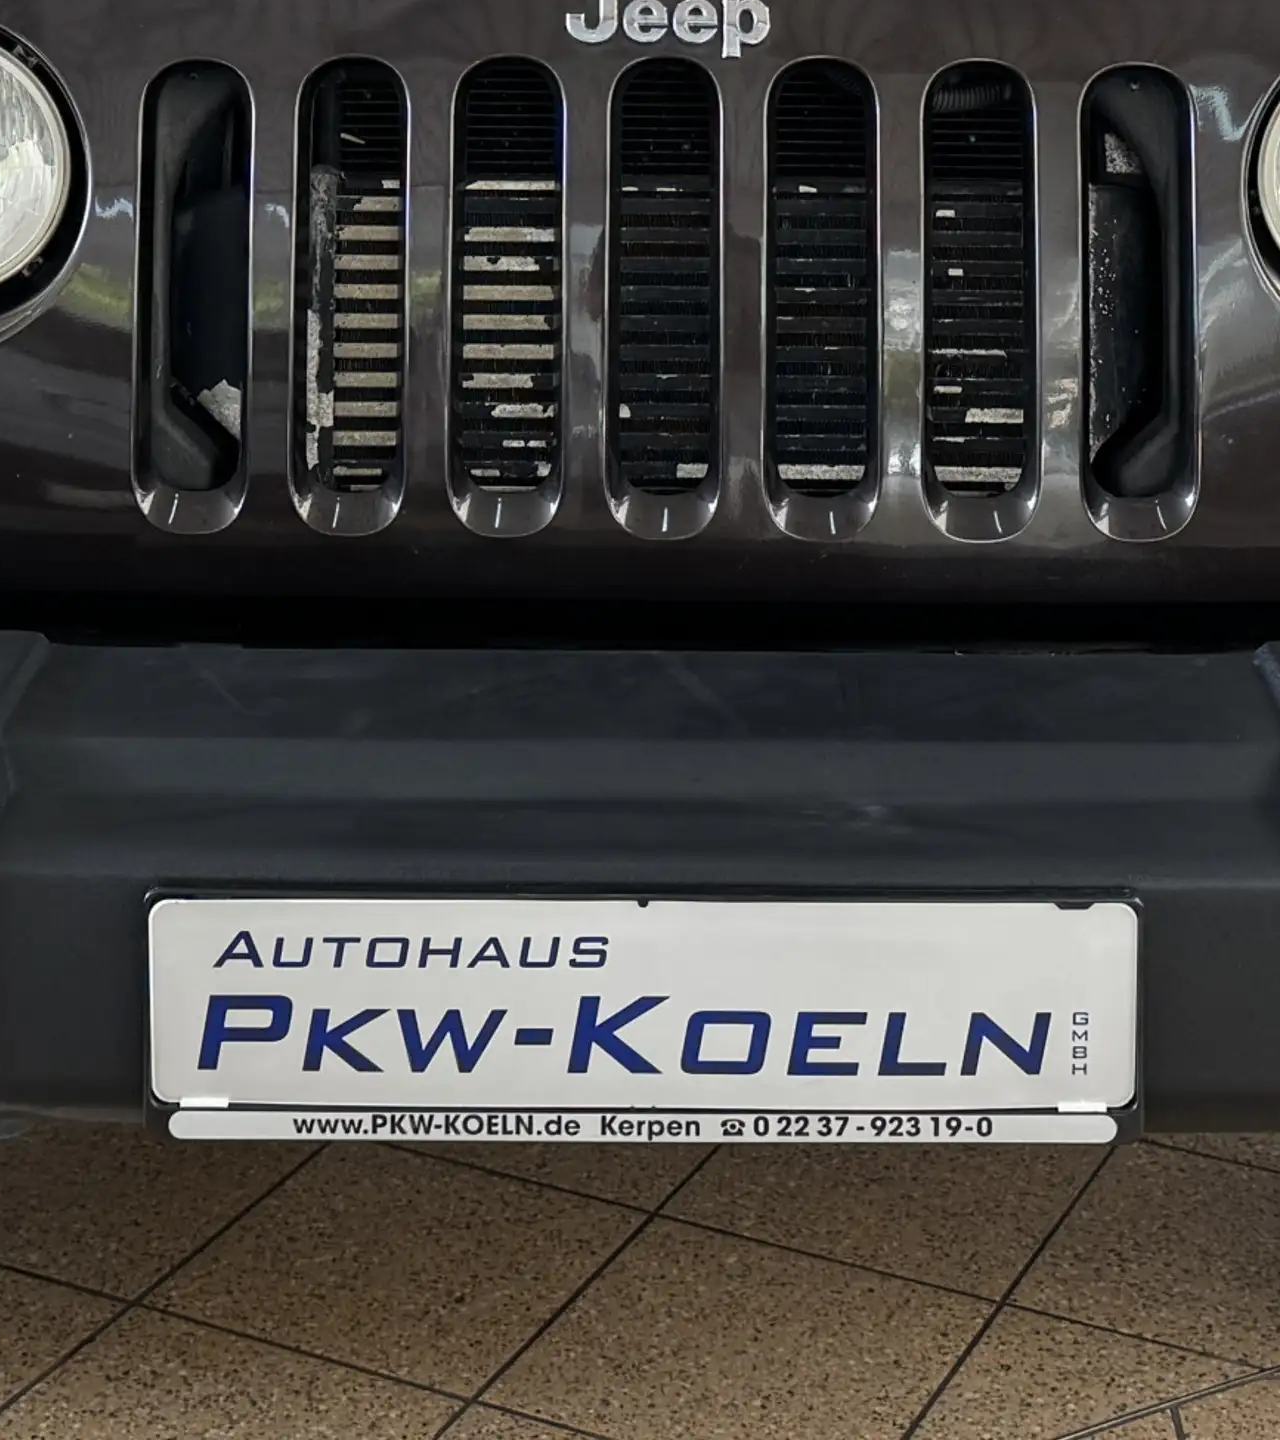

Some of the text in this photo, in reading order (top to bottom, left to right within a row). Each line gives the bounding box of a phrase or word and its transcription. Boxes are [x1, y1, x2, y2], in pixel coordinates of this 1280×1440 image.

[212, 930, 610, 970] AUTOHAUS
[196, 994, 1053, 1078] PKW-KOELN
[1071, 1011, 1090, 1076] GMBH
[292, 1113, 582, 1137] www.PKW-KOELN.de
[600, 1114, 702, 1143] Kerpen
